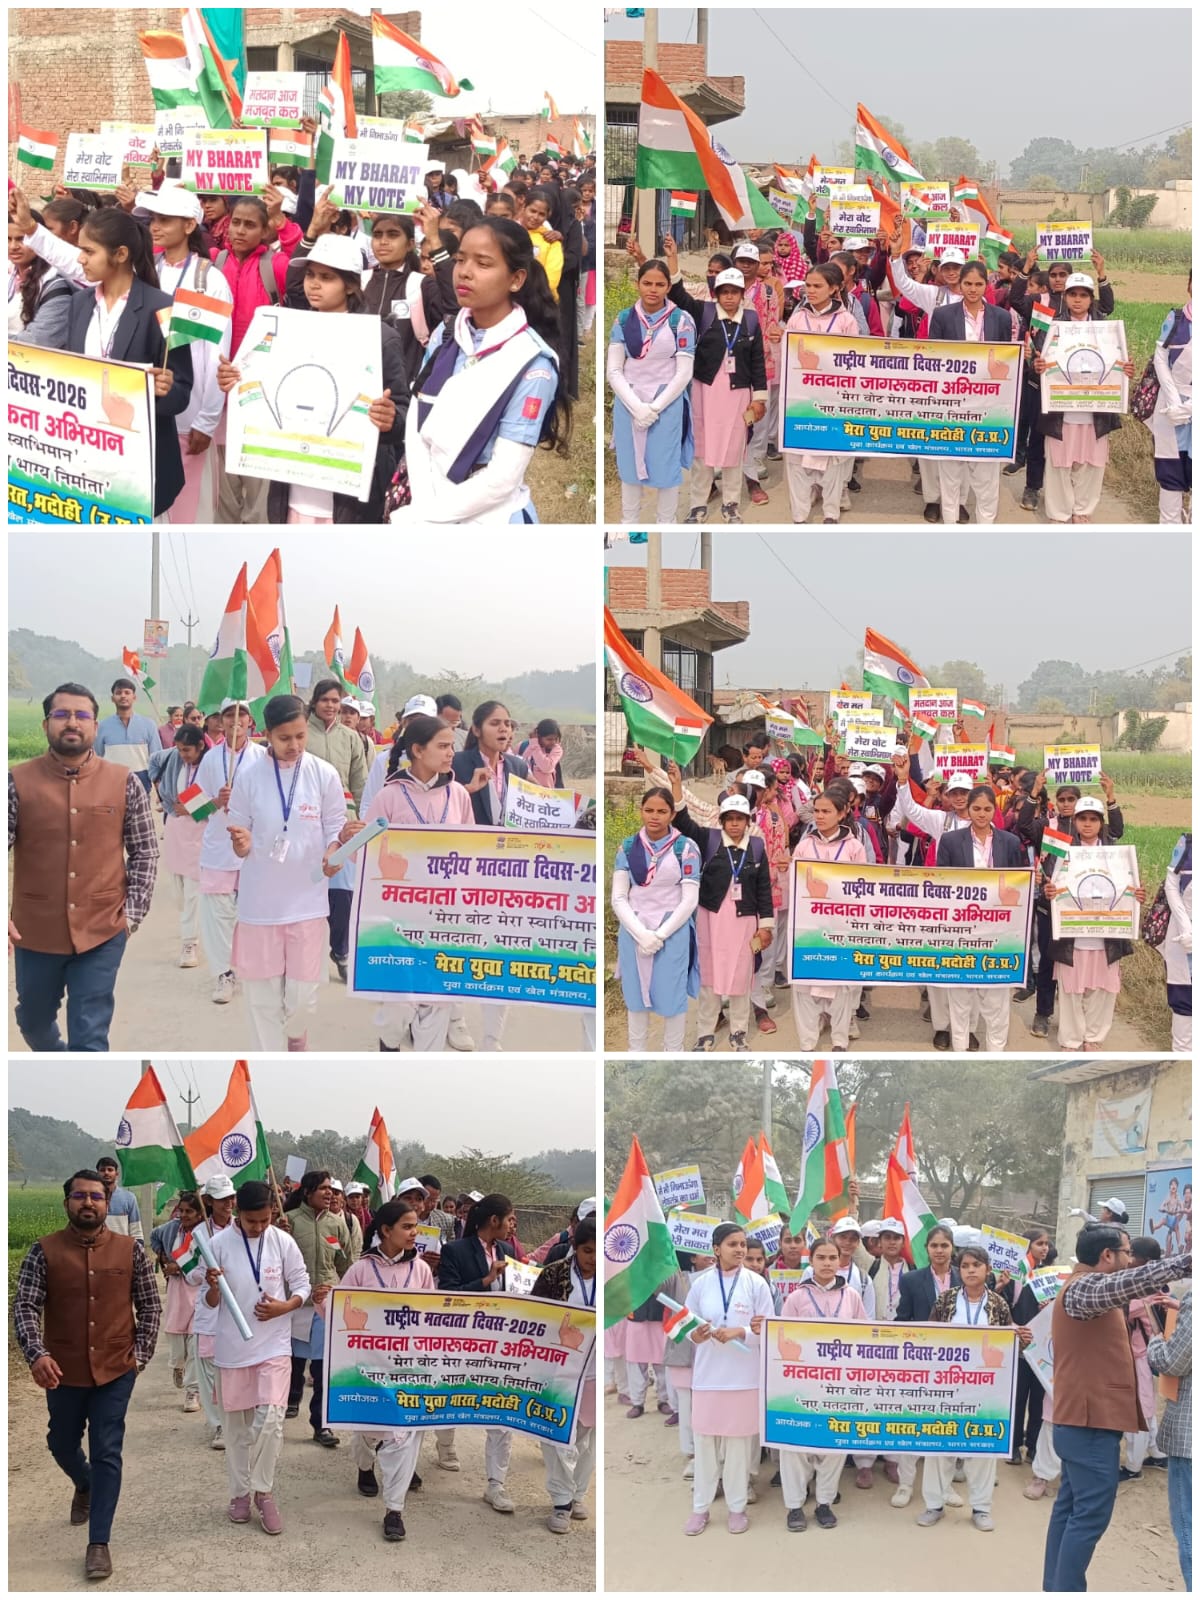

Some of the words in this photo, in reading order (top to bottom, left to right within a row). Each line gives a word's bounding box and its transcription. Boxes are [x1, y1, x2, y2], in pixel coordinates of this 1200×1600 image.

[249, 89, 276, 101] मतदान
[278, 89, 298, 102] आज
[245, 104, 276, 123] मजबूत
[279, 106, 299, 119] कल
[129, 137, 146, 148] वोट
[76, 153, 93, 165] मेरा
[95, 152, 112, 165] वोट
[186, 150, 204, 167] MY
[207, 150, 263, 169] BHARAT
[336, 160, 357, 180] MY
[361, 162, 421, 185] BHARAT
[195, 172, 215, 190] MY
[219, 172, 253, 191] VOTE
[344, 185, 365, 206] MY
[368, 187, 406, 209] VOTE
[838, 212, 853, 222] मेरा
[855, 212, 871, 222] वोट
[928, 233, 941, 244] MY
[943, 234, 977, 246] BHARAT
[1039, 235, 1053, 246] MY
[1055, 233, 1090, 245] BHARAT
[1046, 249, 1060, 259] MY
[1061, 247, 1084, 259] VOTE
[833, 349, 866, 371] राष्ट्रीय
[870, 354, 908, 370] मतदाता
[913, 353, 977, 375] दिवस-2026
[802, 373, 856, 389] मतदाता
[860, 376, 938, 393] जागरूकता
[941, 377, 1000, 395] अभियान
[864, 391, 883, 403] वोट
[887, 393, 905, 404] मेरा
[885, 409, 912, 418] भारत
[916, 410, 944, 419] भाग्य
[45, 411, 124, 455] अभियान
[843, 421, 864, 436] मेरा
[868, 424, 891, 440] युवा
[17, 457, 50, 479] भाग्य
[913, 699, 937, 708] मतदान
[938, 699, 953, 708] आज
[940, 709, 955, 717] कल
[854, 736, 870, 746] मेरा
[871, 737, 887, 747] वोट
[936, 755, 949, 767] MY
[950, 755, 985, 766] BHARAT
[1047, 759, 1061, 769] MY
[1063, 757, 1098, 769] BHARAT
[1054, 772, 1068, 783] MY
[1069, 770, 1092, 783] VOTE
[516, 795, 535, 813] मेरा
[538, 802, 561, 817] वोट
[509, 809, 522, 825] मेरा
[426, 851, 472, 880] राष्ट्रीय
[475, 855, 530, 878] मतदाता
[842, 877, 875, 899] राष्ट्रीय
[879, 882, 918, 898] मतदाता
[923, 880, 988, 901] दिवस-2026
[381, 884, 457, 906] मतदाता
[461, 887, 570, 911] जागरूकता
[465, 912, 492, 925] वोट
[497, 912, 521, 927] मेरा
[810, 901, 865, 918] मतदाता
[869, 904, 949, 922] जागरूकता
[952, 904, 1012, 922] अभियान
[873, 920, 894, 932] वोट
[898, 921, 917, 933] मेरा
[494, 934, 531, 948] भारत
[538, 937, 577, 951] भाग्य
[896, 937, 923, 947] भारत
[927, 938, 954, 948] भाग्य
[367, 953, 415, 966] आयोजक
[435, 951, 463, 972] मेरा
[469, 957, 503, 981] युवा
[853, 950, 874, 966] मेरा
[879, 953, 901, 970] युवा
[442, 980, 461, 991] युवा
[464, 981, 503, 992] कार्यक्रम
[507, 984, 521, 994] एवं
[525, 985, 545, 996] खेल
[673, 1223, 690, 1236] मेरा
[691, 1226, 709, 1237] मत
[683, 1237, 710, 1250] ताकत
[987, 1241, 1003, 1255] मेरा
[1005, 1247, 1019, 1261] वोट
[1031, 1277, 1045, 1289] MY
[383, 1304, 419, 1330] राष्ट्रीय
[423, 1309, 470, 1329] मतदाता
[472, 1310, 547, 1337] दिवस-2026
[347, 1334, 409, 1352] मतदाता
[413, 1335, 498, 1355] जागरूकता
[500, 1337, 569, 1366] अभियान
[816, 1338, 851, 1361] राष्ट्रीय
[856, 1344, 898, 1360] मतदाता
[903, 1342, 970, 1362] दिवस-2026
[417, 1355, 437, 1368] वोट
[442, 1355, 461, 1368] मेरा
[440, 1373, 466, 1385] भारत
[470, 1374, 499, 1386] भाग्य
[782, 1364, 841, 1381] मतदाता
[846, 1367, 929, 1384] जागरूकता
[933, 1365, 995, 1386] अभियान
[850, 1386, 872, 1398] वोट
[876, 1386, 895, 1398] मेरा
[338, 1393, 378, 1403] आयोजक
[395, 1390, 419, 1408] मेरा
[424, 1393, 448, 1413] युवा
[873, 1402, 902, 1413] भारत
[907, 1403, 935, 1414] भाग्य
[827, 1417, 850, 1433] मेरा
[855, 1420, 880, 1438] युवा
